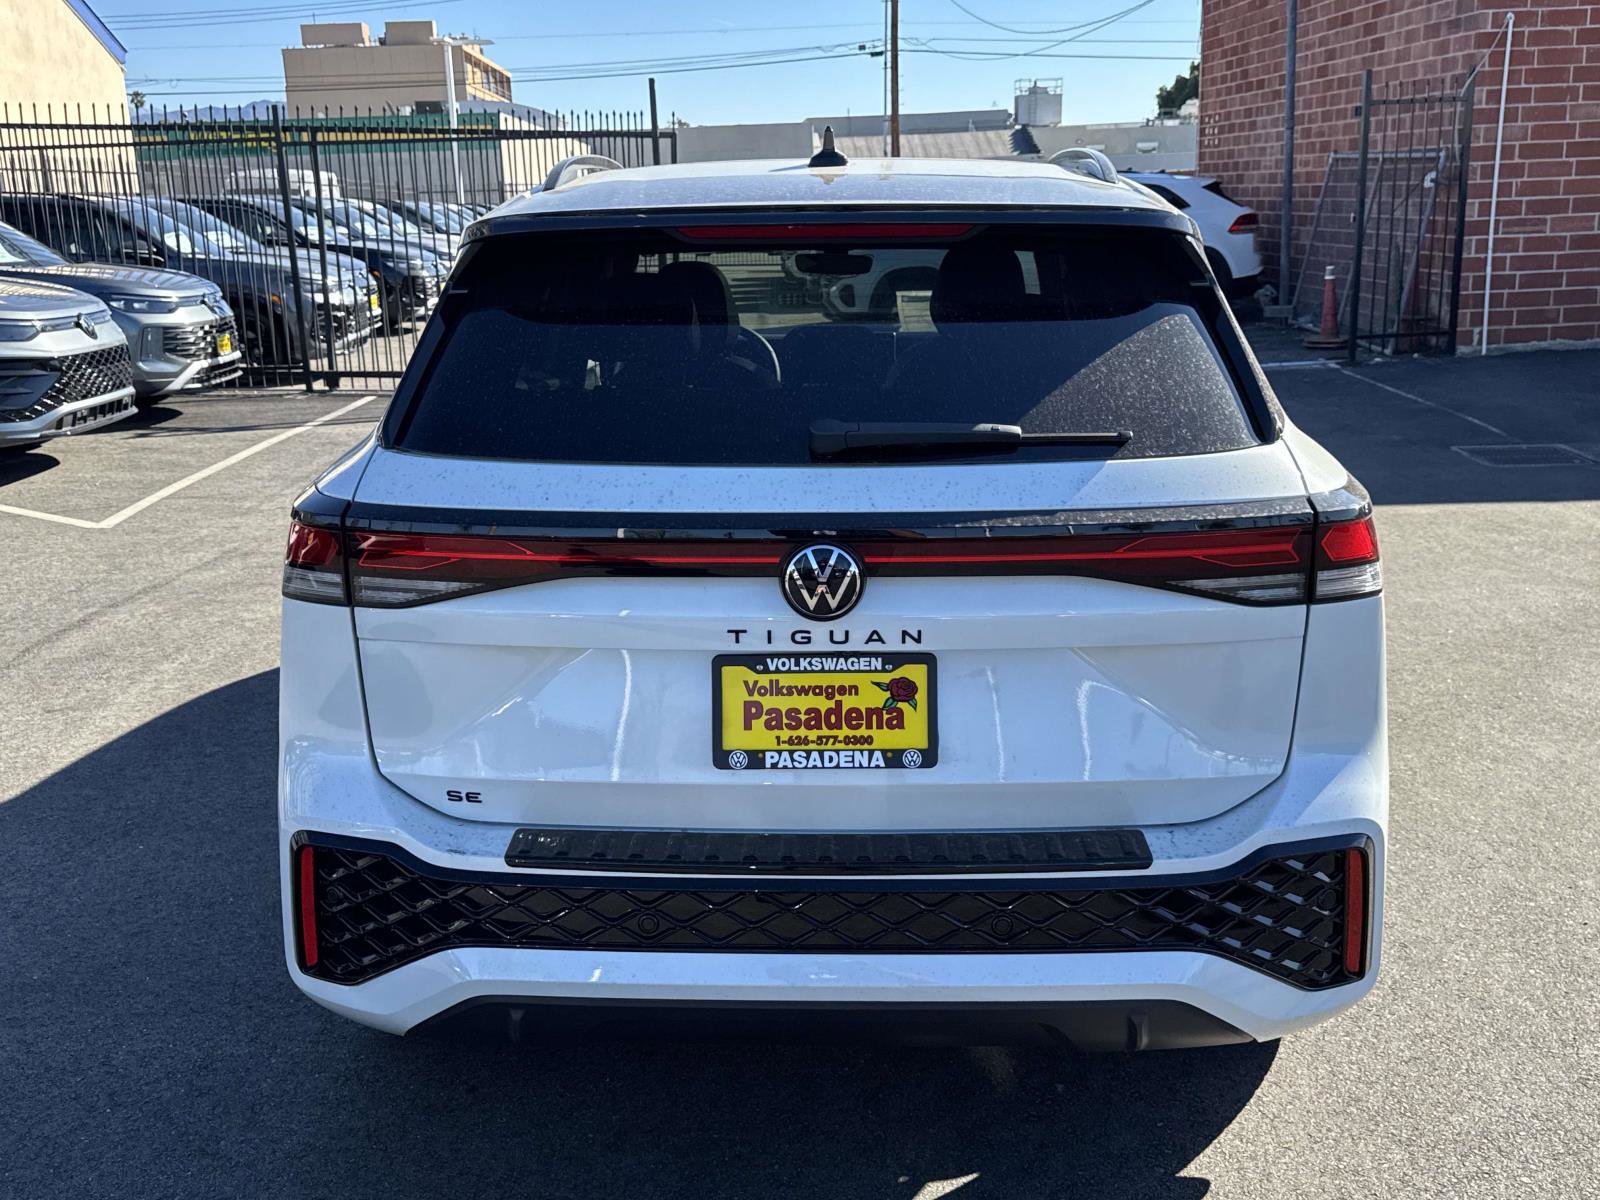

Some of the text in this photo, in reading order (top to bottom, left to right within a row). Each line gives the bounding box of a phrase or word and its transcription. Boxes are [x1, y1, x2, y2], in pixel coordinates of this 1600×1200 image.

[785, 545, 860, 616] VW
[727, 629, 922, 645] TIGUAN
[766, 657, 882, 672] VOLKSWAGEN
[743, 679, 859, 701] Volkswagen
[743, 700, 905, 732] Pasadena
[775, 735, 874, 746] 1-626-577-0300
[765, 751, 885, 768] PASADENA
[446, 790, 482, 803] SE
